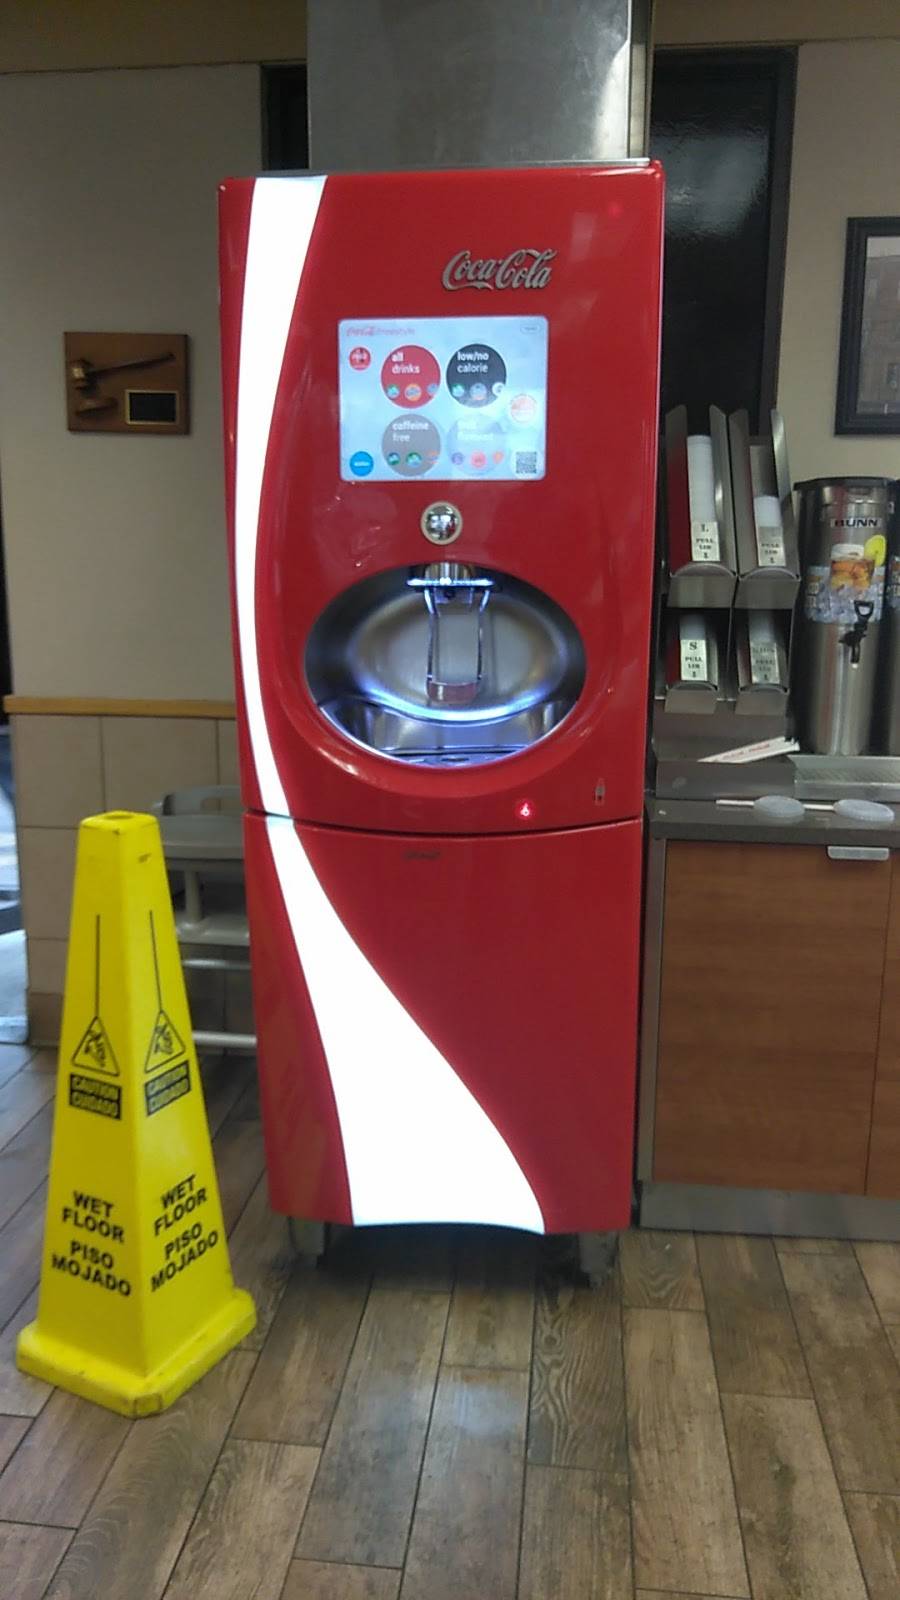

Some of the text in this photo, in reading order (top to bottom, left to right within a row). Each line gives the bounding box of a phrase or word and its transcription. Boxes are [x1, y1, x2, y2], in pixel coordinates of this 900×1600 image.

[442, 249, 557, 291] Coca-Cola
[392, 352, 404, 362] all
[392, 364, 420, 374] drinks
[457, 352, 489, 362] low/no
[457, 363, 488, 373] calorie
[392, 420, 429, 431] caffeine
[392, 433, 410, 442] free
[834, 519, 879, 528] BUNN
[689, 641, 698, 650] S
[73, 1190, 114, 1218] WET
[160, 1173, 196, 1209] WET
[62, 1207, 124, 1243] FLOOR
[154, 1188, 207, 1236] FLOOR
[70, 1240, 114, 1270] PISO
[164, 1222, 202, 1260] PISO
[52, 1254, 131, 1296] MOJADO
[151, 1230, 218, 1292] MOJADO
